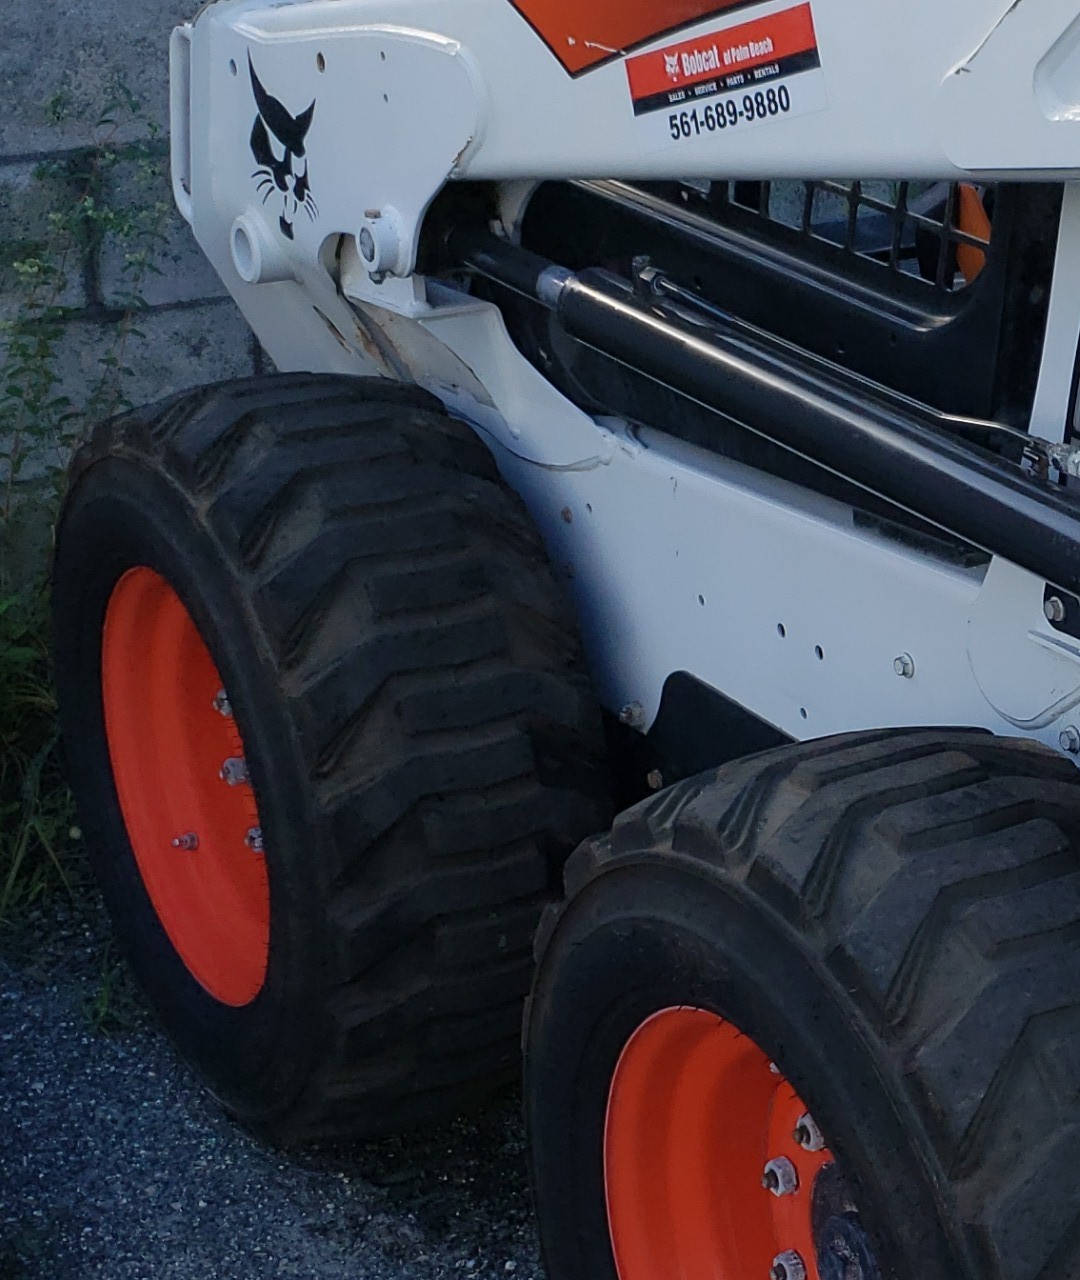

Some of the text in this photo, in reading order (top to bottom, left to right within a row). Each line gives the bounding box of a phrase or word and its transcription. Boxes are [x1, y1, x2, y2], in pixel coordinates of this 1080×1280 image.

[681, 44, 721, 76] Bobcat
[731, 42, 750, 63] Palm
[749, 37, 774, 58] Beach
[669, 85, 790, 140] 561-689-9880
